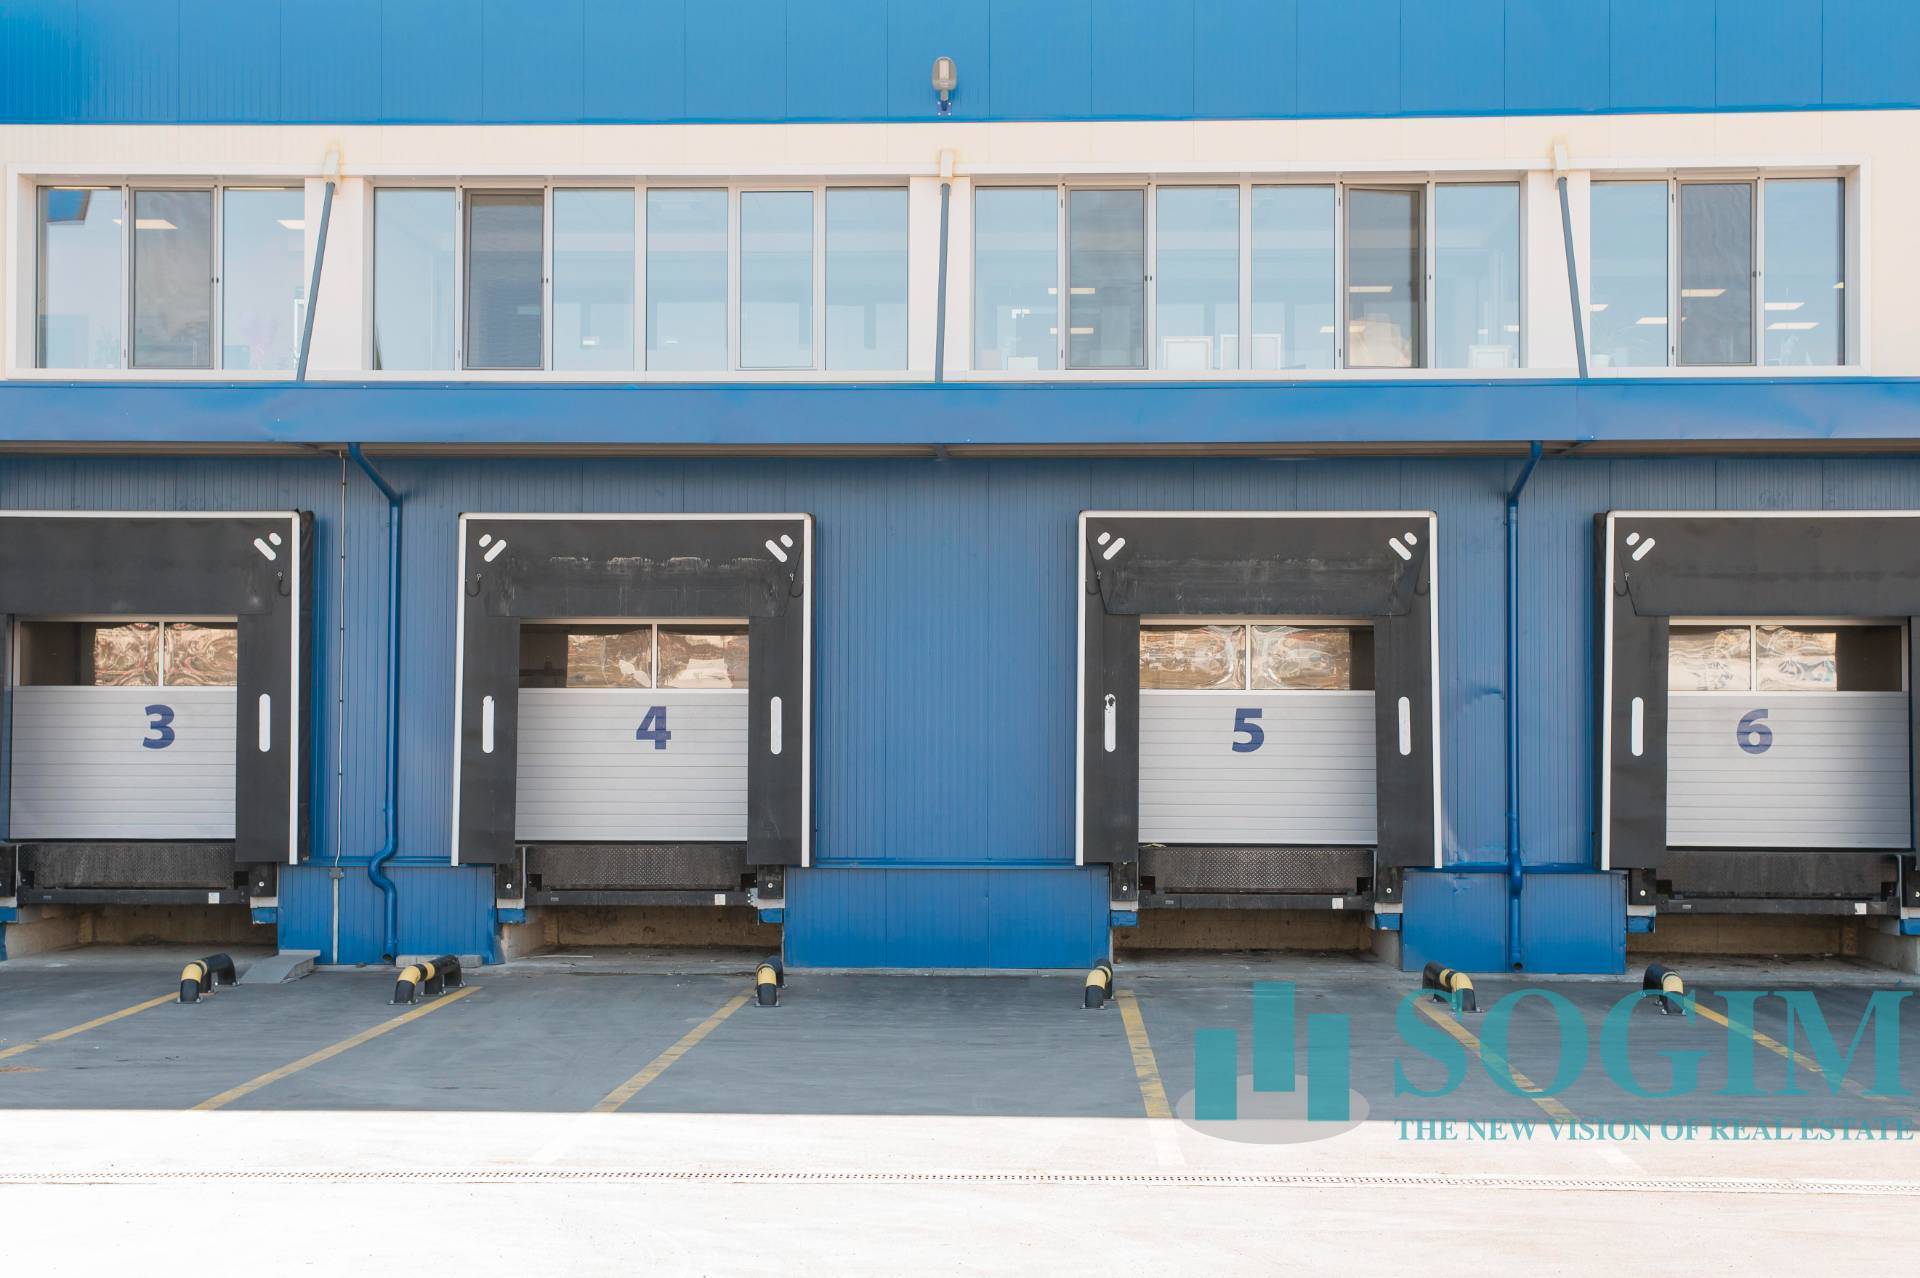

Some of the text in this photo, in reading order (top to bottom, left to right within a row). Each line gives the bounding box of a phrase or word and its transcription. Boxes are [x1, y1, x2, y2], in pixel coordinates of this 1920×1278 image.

[143, 704, 175, 749] 3
[635, 706, 671, 750] 4
[1232, 708, 1264, 753] 5
[1737, 708, 1773, 755] 6
